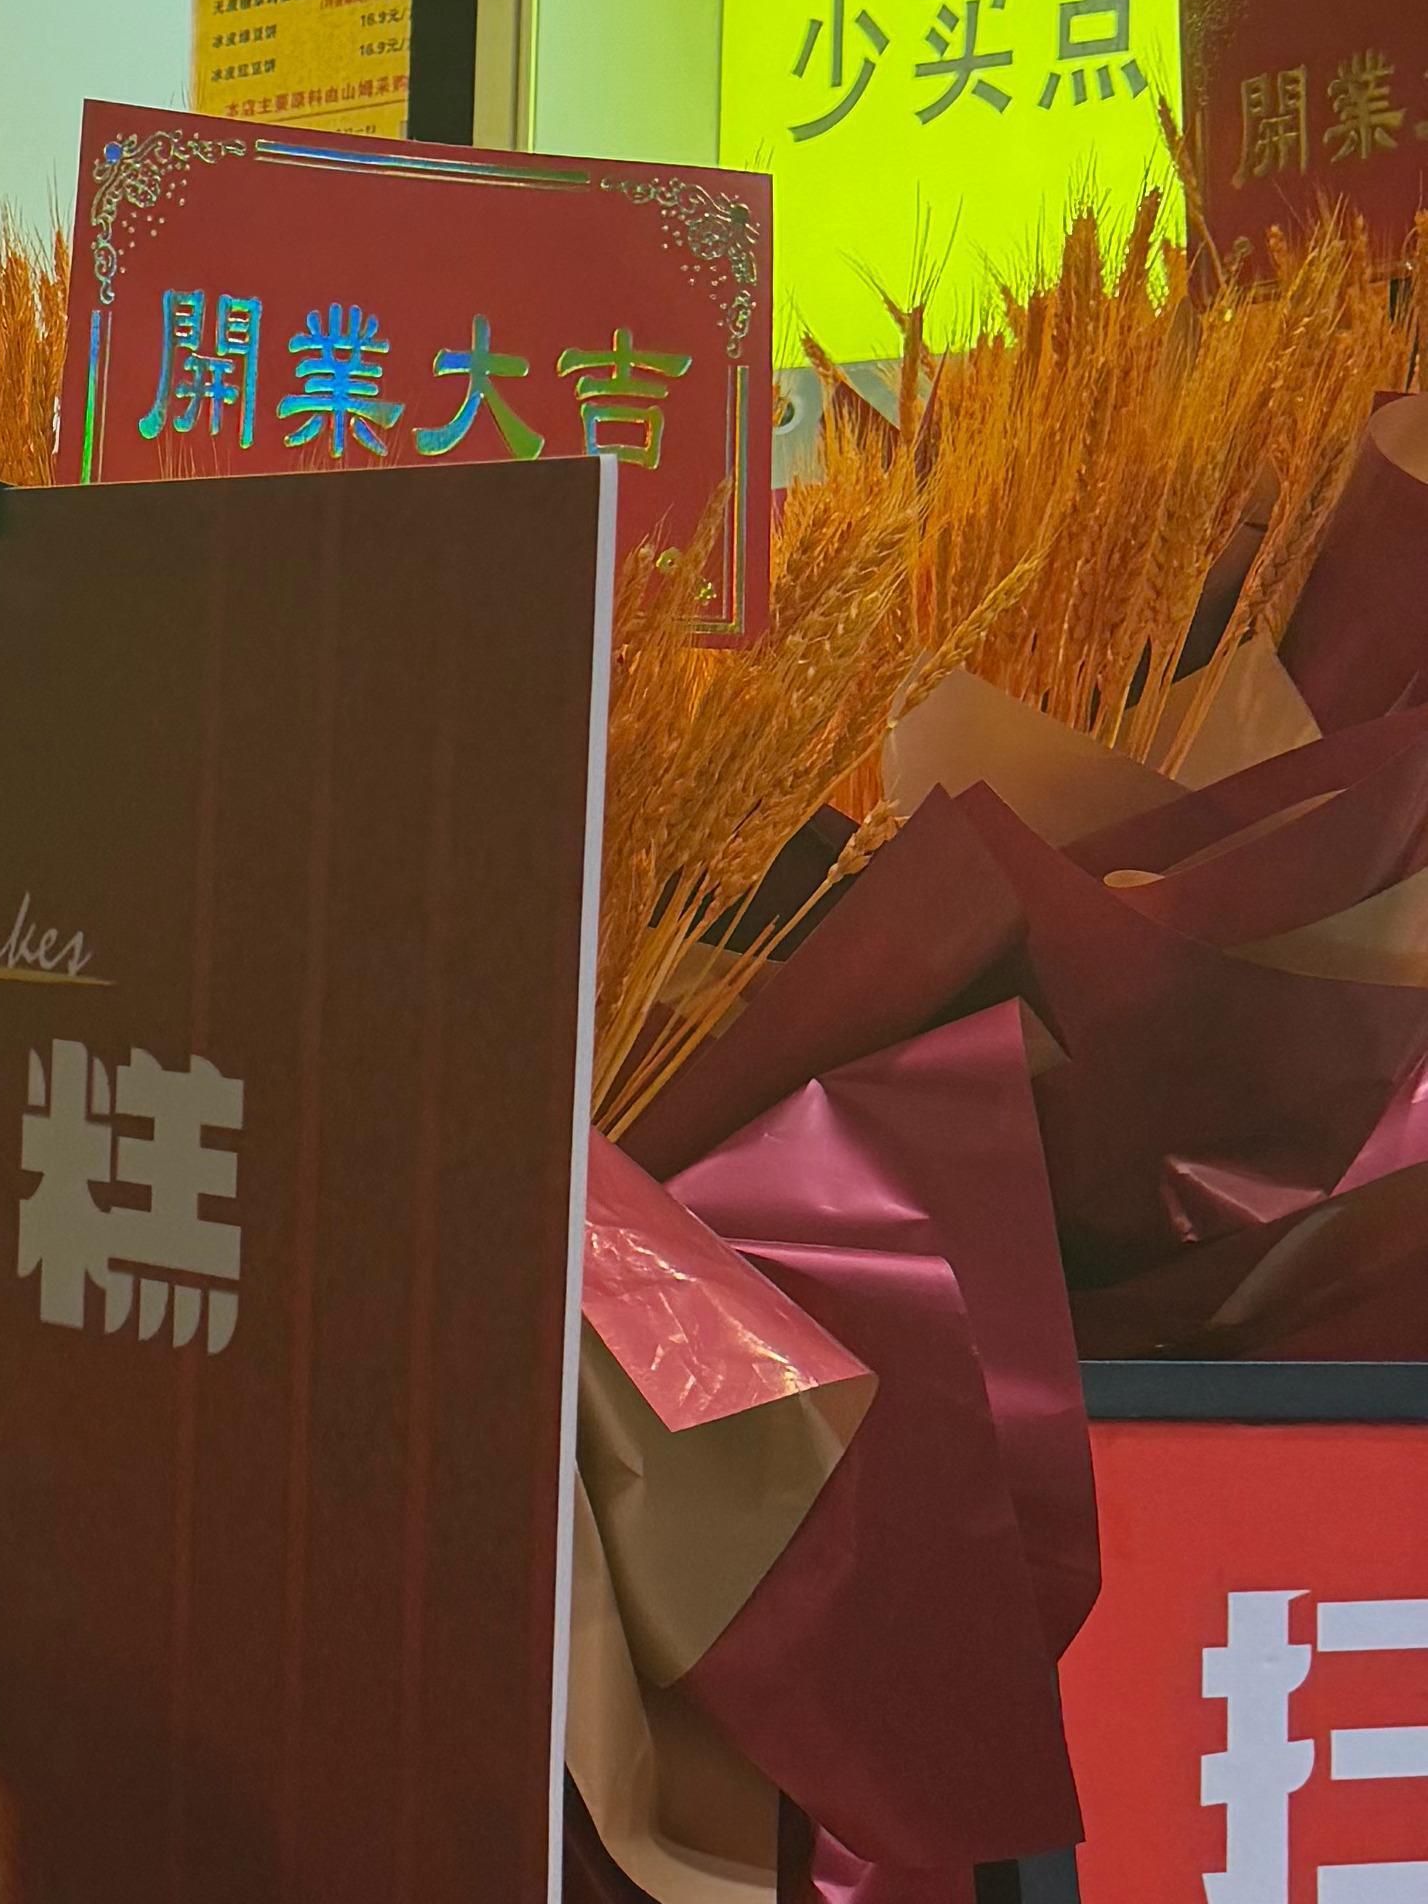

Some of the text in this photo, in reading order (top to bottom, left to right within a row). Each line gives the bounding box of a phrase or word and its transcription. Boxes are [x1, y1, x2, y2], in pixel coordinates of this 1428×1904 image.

[1231, 47, 1428, 191] 開業
[138, 288, 694, 471] 開業大吉
